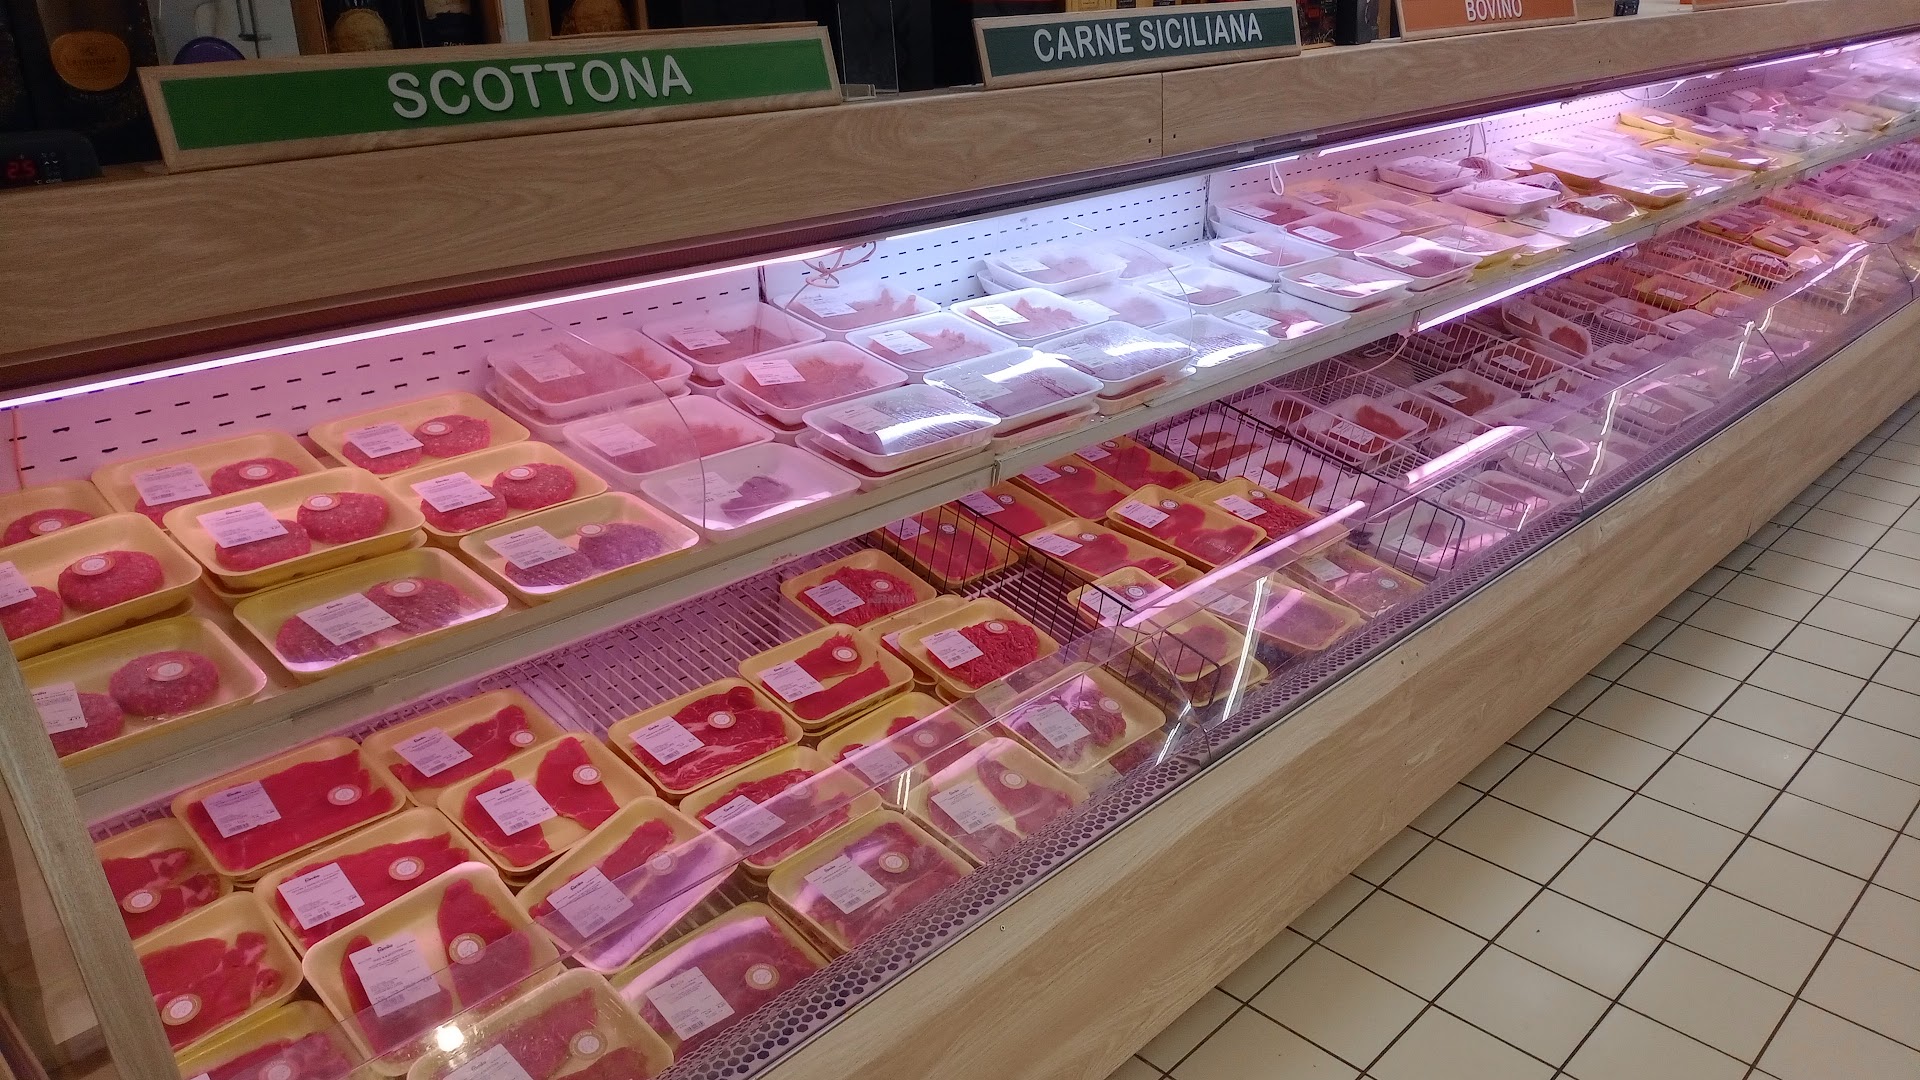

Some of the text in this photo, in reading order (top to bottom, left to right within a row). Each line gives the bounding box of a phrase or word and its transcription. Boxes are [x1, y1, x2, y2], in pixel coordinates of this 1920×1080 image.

[1465, 0, 1523, 21] BOVINO
[1034, 13, 1263, 62] CARNE SICILIANA
[388, 55, 692, 118] SCOTTONA
